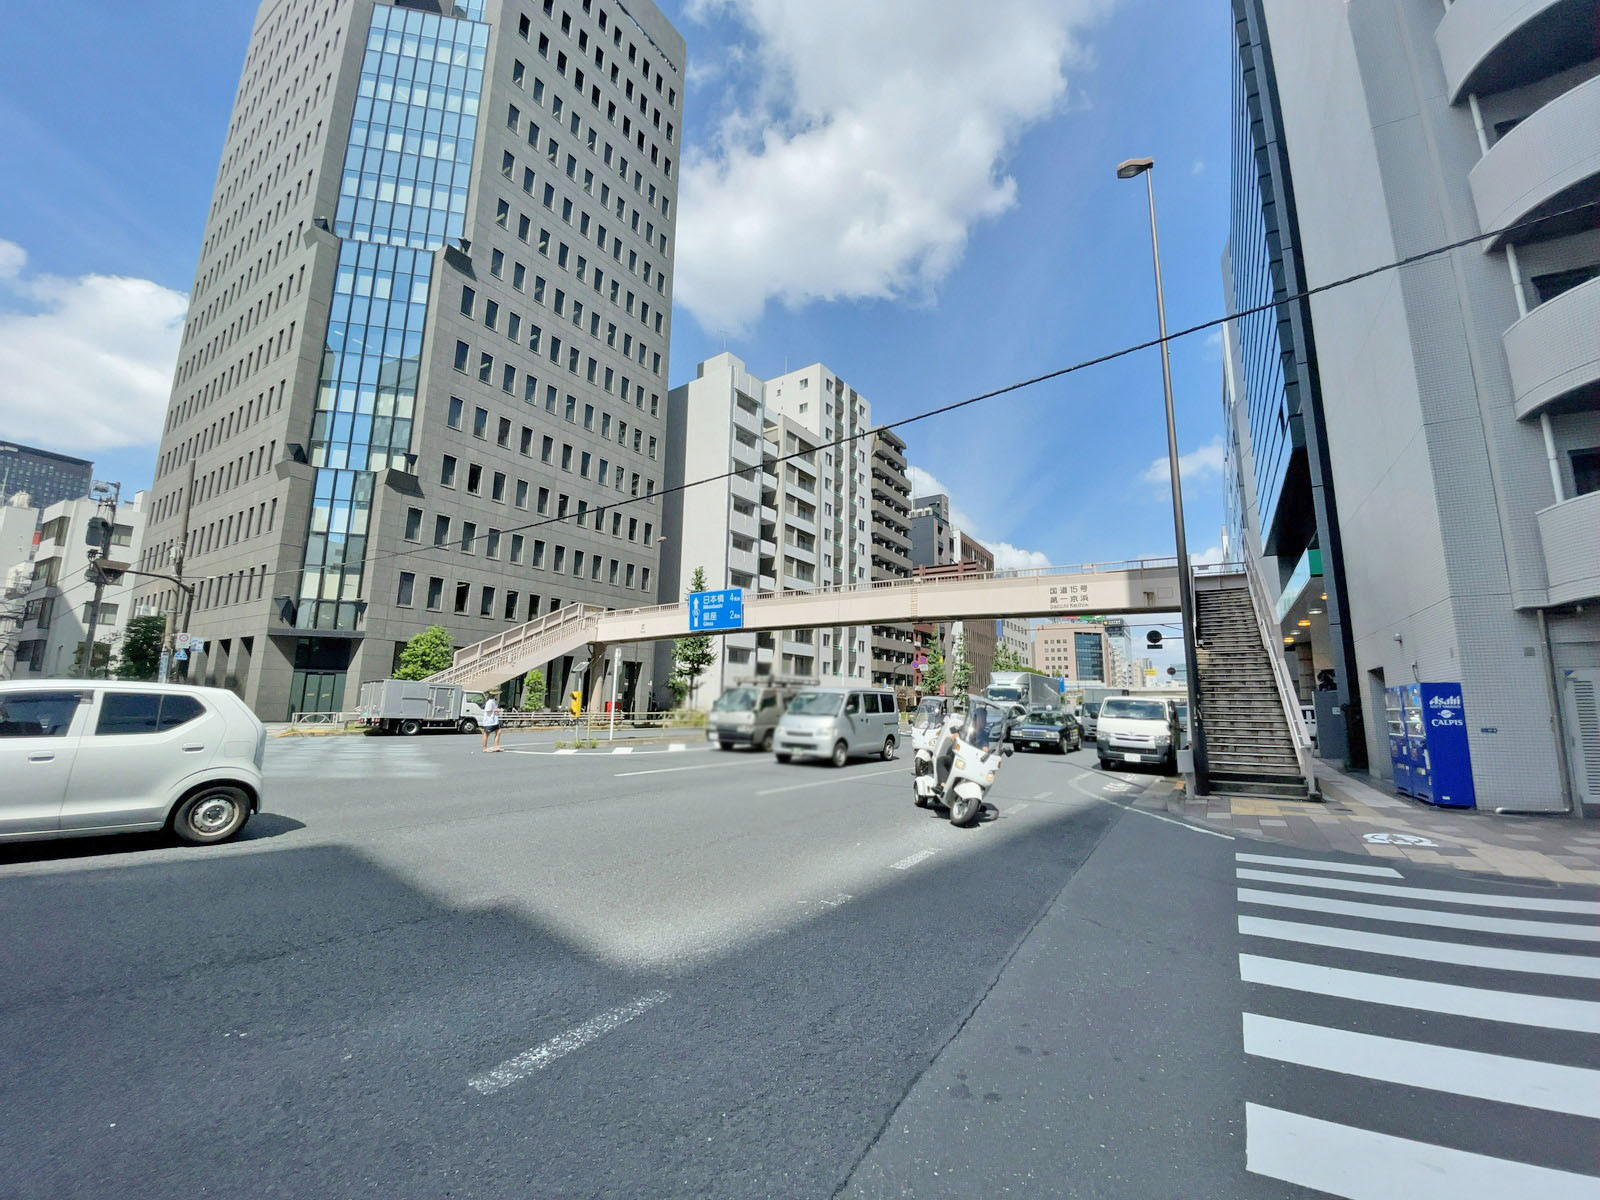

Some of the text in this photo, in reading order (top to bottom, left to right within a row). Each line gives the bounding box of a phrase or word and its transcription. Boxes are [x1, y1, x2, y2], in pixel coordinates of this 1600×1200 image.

[1049, 585, 1088, 594] 国道15号
[703, 594, 724, 604] 日本橋
[1050, 594, 1089, 603] 第一京浜
[703, 612, 717, 621] 銀座
[1429, 695, 1461, 705] Asahi
[1431, 719, 1464, 727] CALPIS
